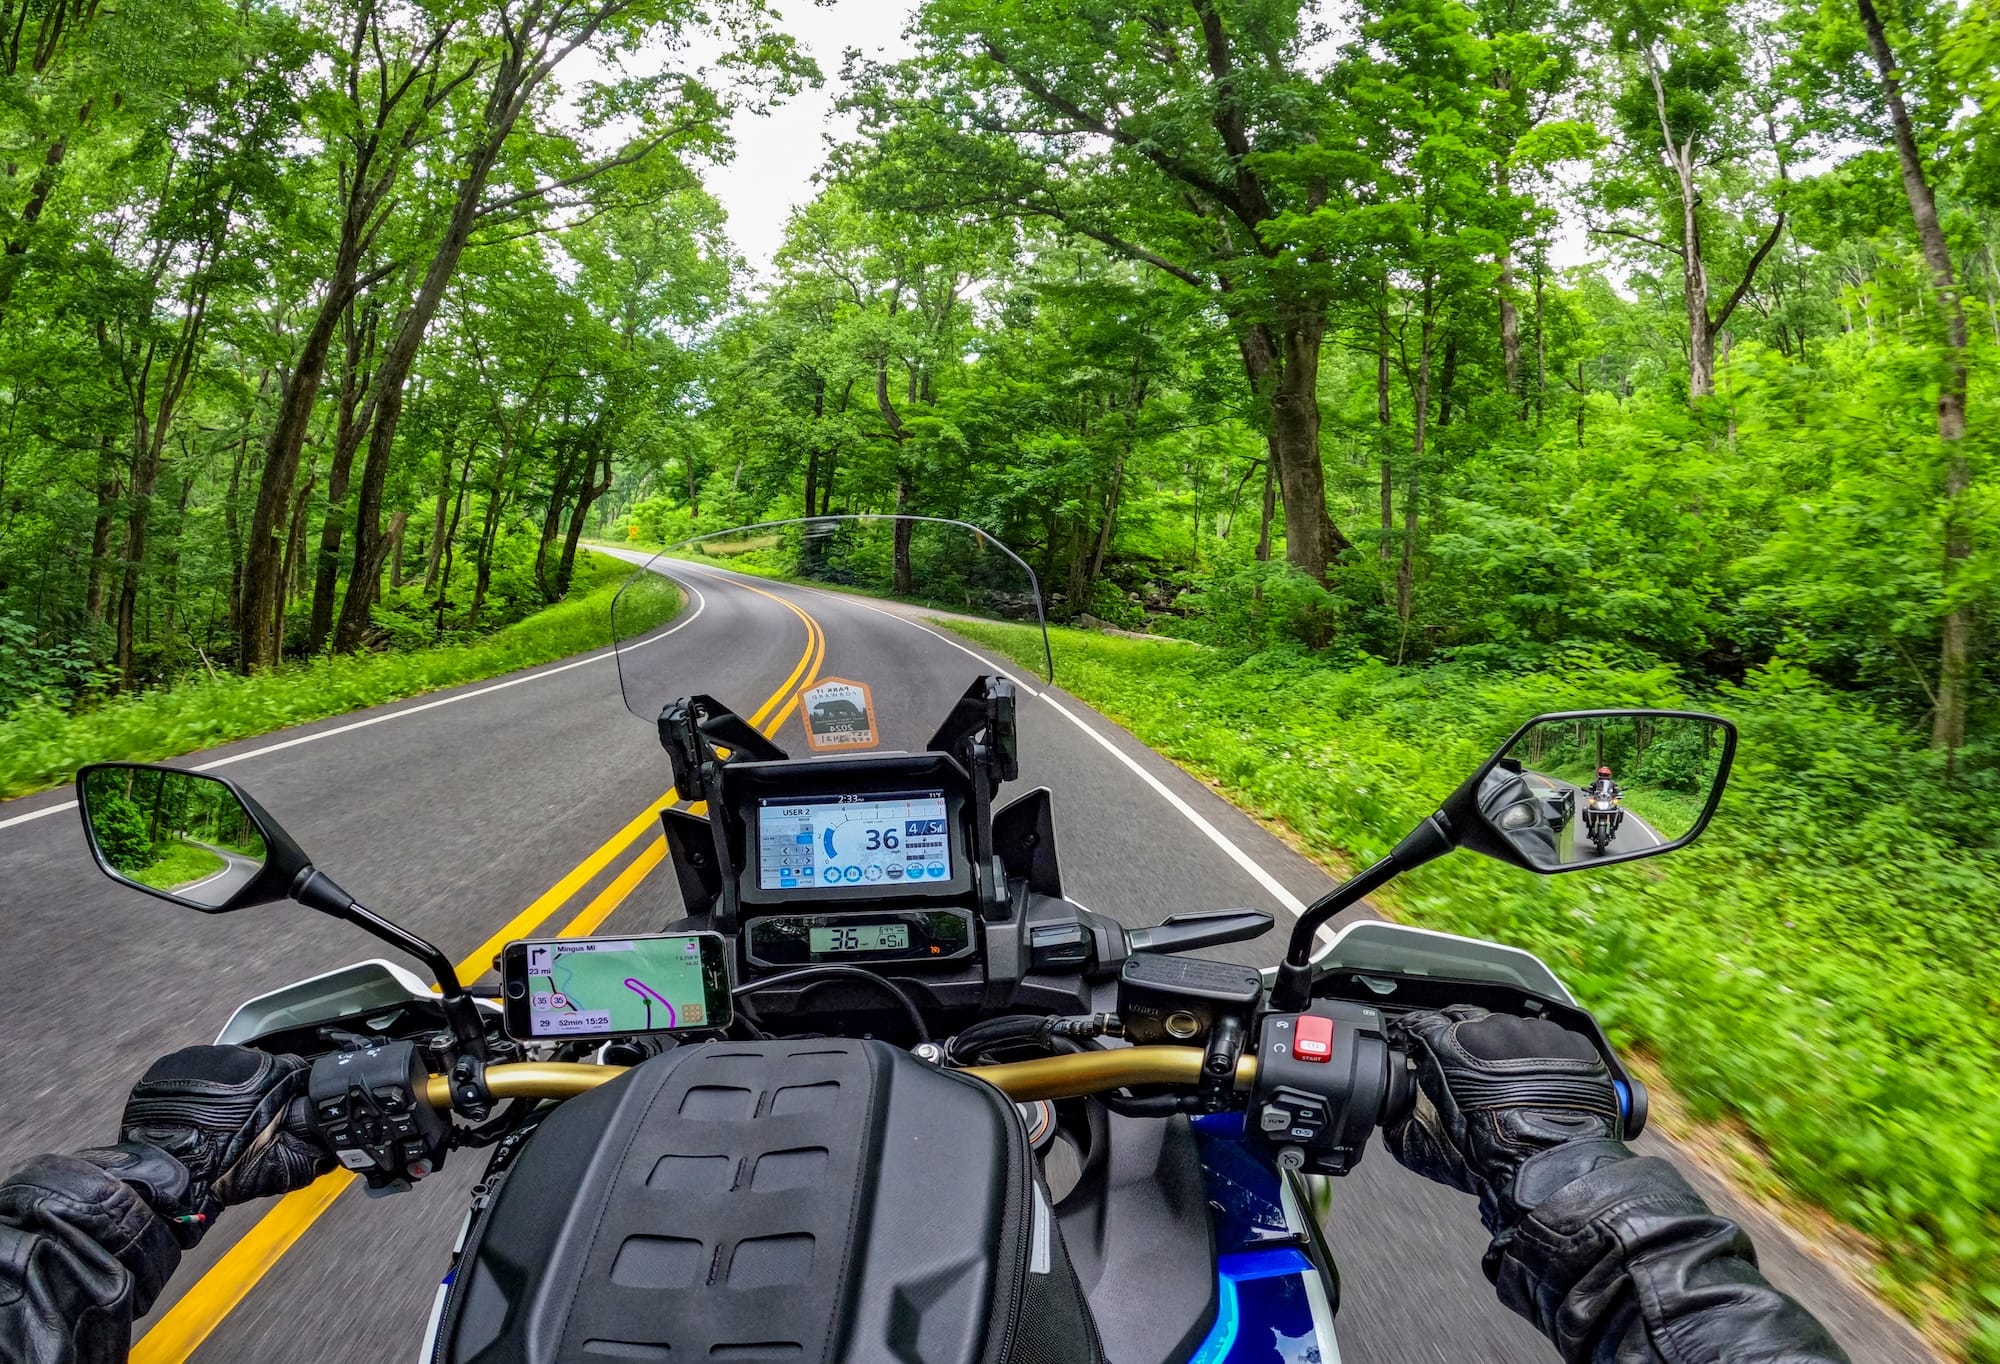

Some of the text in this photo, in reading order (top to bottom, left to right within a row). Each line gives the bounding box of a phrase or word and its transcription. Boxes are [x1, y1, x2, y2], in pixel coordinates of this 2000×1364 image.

[838, 794, 858, 804] 2:33
[782, 808, 810, 817] USER 2
[865, 828, 899, 851] 36
[830, 928, 859, 950] 36
[557, 945, 585, 953] Mingus
[541, 967, 551, 975] mi
[537, 997, 547, 1005] 35
[553, 996, 564, 1004] 35
[558, 1019, 583, 1027] 52min
[585, 1017, 609, 1025] 15:25
